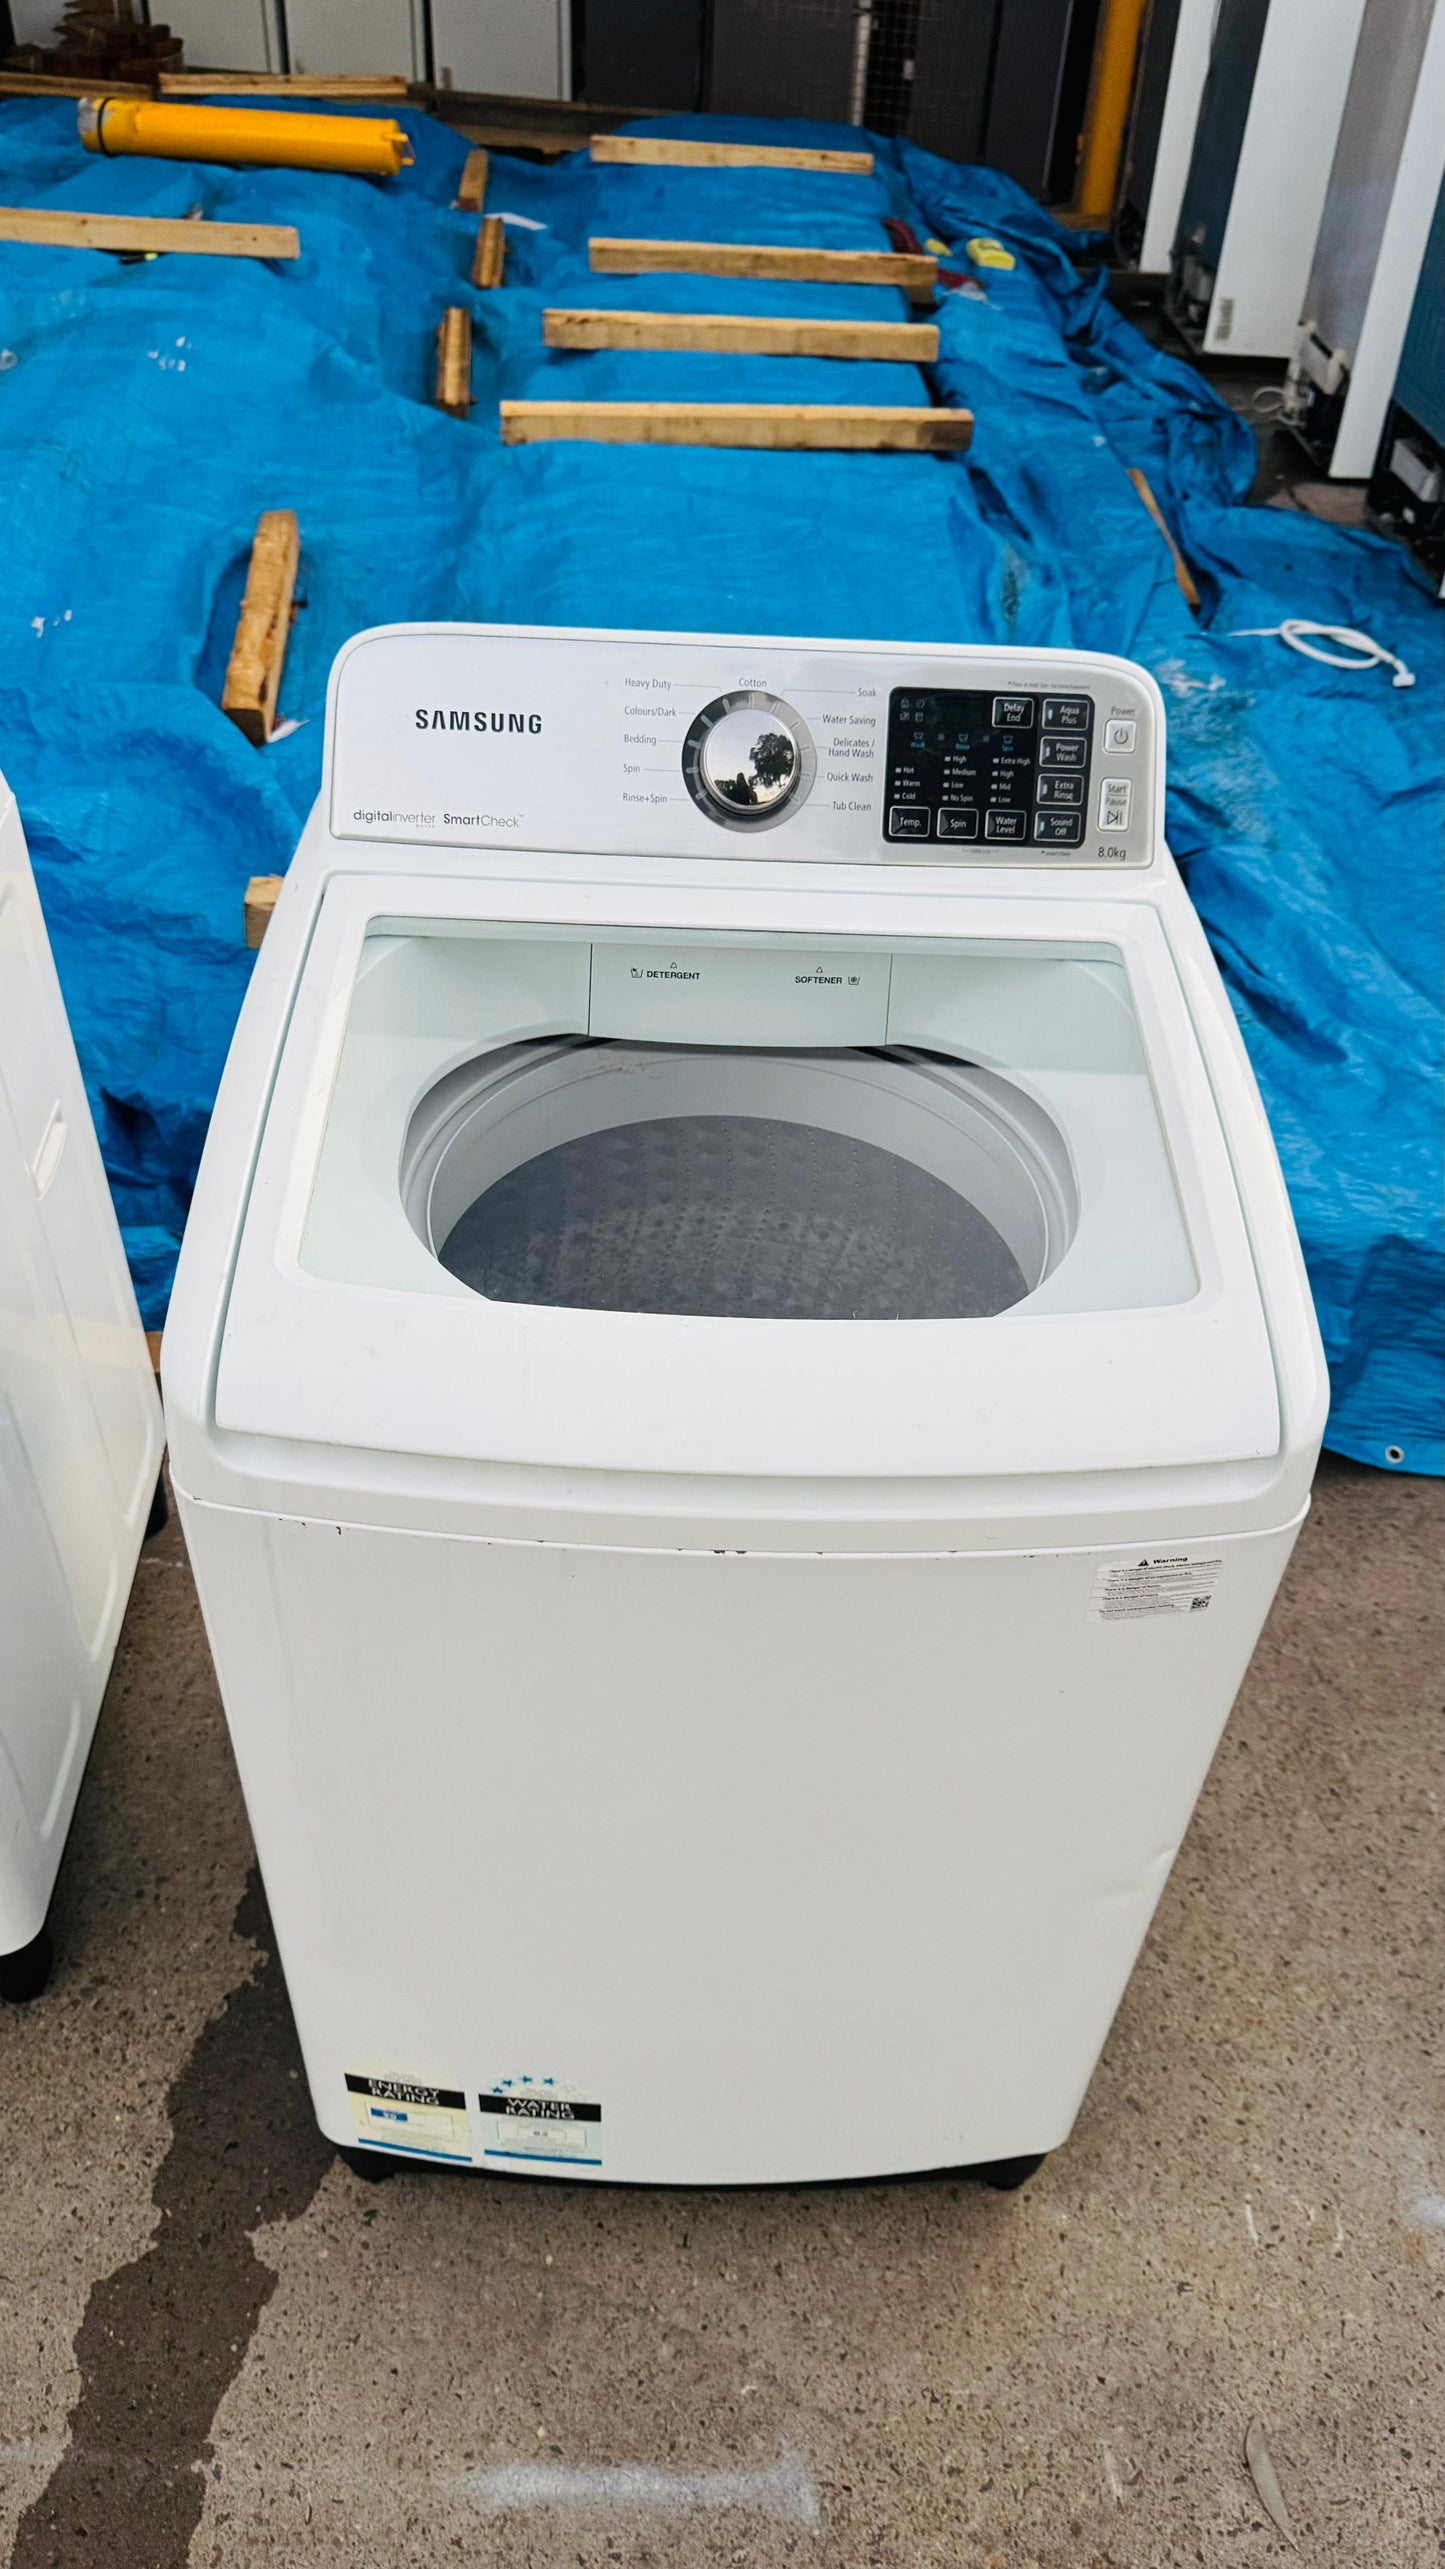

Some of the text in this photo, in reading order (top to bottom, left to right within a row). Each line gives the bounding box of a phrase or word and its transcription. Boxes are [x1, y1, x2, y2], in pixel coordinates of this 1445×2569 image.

[625, 678, 672, 691] Heavy Duty
[738, 677, 767, 688] Cotton
[858, 687, 877, 697] Soak
[624, 706, 677, 717] Colours/Dark
[1003, 702, 1025, 714] Delay
[1060, 705, 1080, 716] Aqua
[1111, 706, 1137, 716] Power
[415, 709, 542, 734] SAMSUNG
[822, 714, 876, 727] Water Saving
[1006, 713, 1021, 722] End
[1061, 716, 1078, 724] Plus
[624, 734, 657, 746] Bedding
[833, 738, 869, 748] Delicates
[828, 748, 874, 758] Hand Wash
[1056, 743, 1079, 753] Power
[1056, 753, 1077, 762] Wash
[623, 763, 641, 775] Spin
[952, 768, 976, 776] Medium
[827, 772, 873, 783] Quick Wash
[1054, 780, 1074, 790] Extra
[1107, 784, 1127, 794] Start
[623, 793, 668, 804] Rinse+Spin
[1054, 790, 1073, 800] Rinse
[832, 801, 872, 812] Tub Clean
[900, 817, 922, 828] Temp.
[950, 819, 967, 830] Spin
[995, 816, 1017, 825] Water
[1050, 817, 1073, 827] Sound
[996, 825, 1016, 834] Level
[1055, 827, 1067, 837] Off
[1098, 846, 1127, 860] 8.0kg
[646, 970, 700, 980] DETERGENT
[795, 975, 843, 985] SOFTENER
[1153, 1556, 1188, 1565] Warning
[368, 2079, 439, 2097] ENERGY
[371, 2087, 440, 2105] RATING
[507, 2098, 572, 2111] WATER
[505, 2105, 575, 2119] RATING
